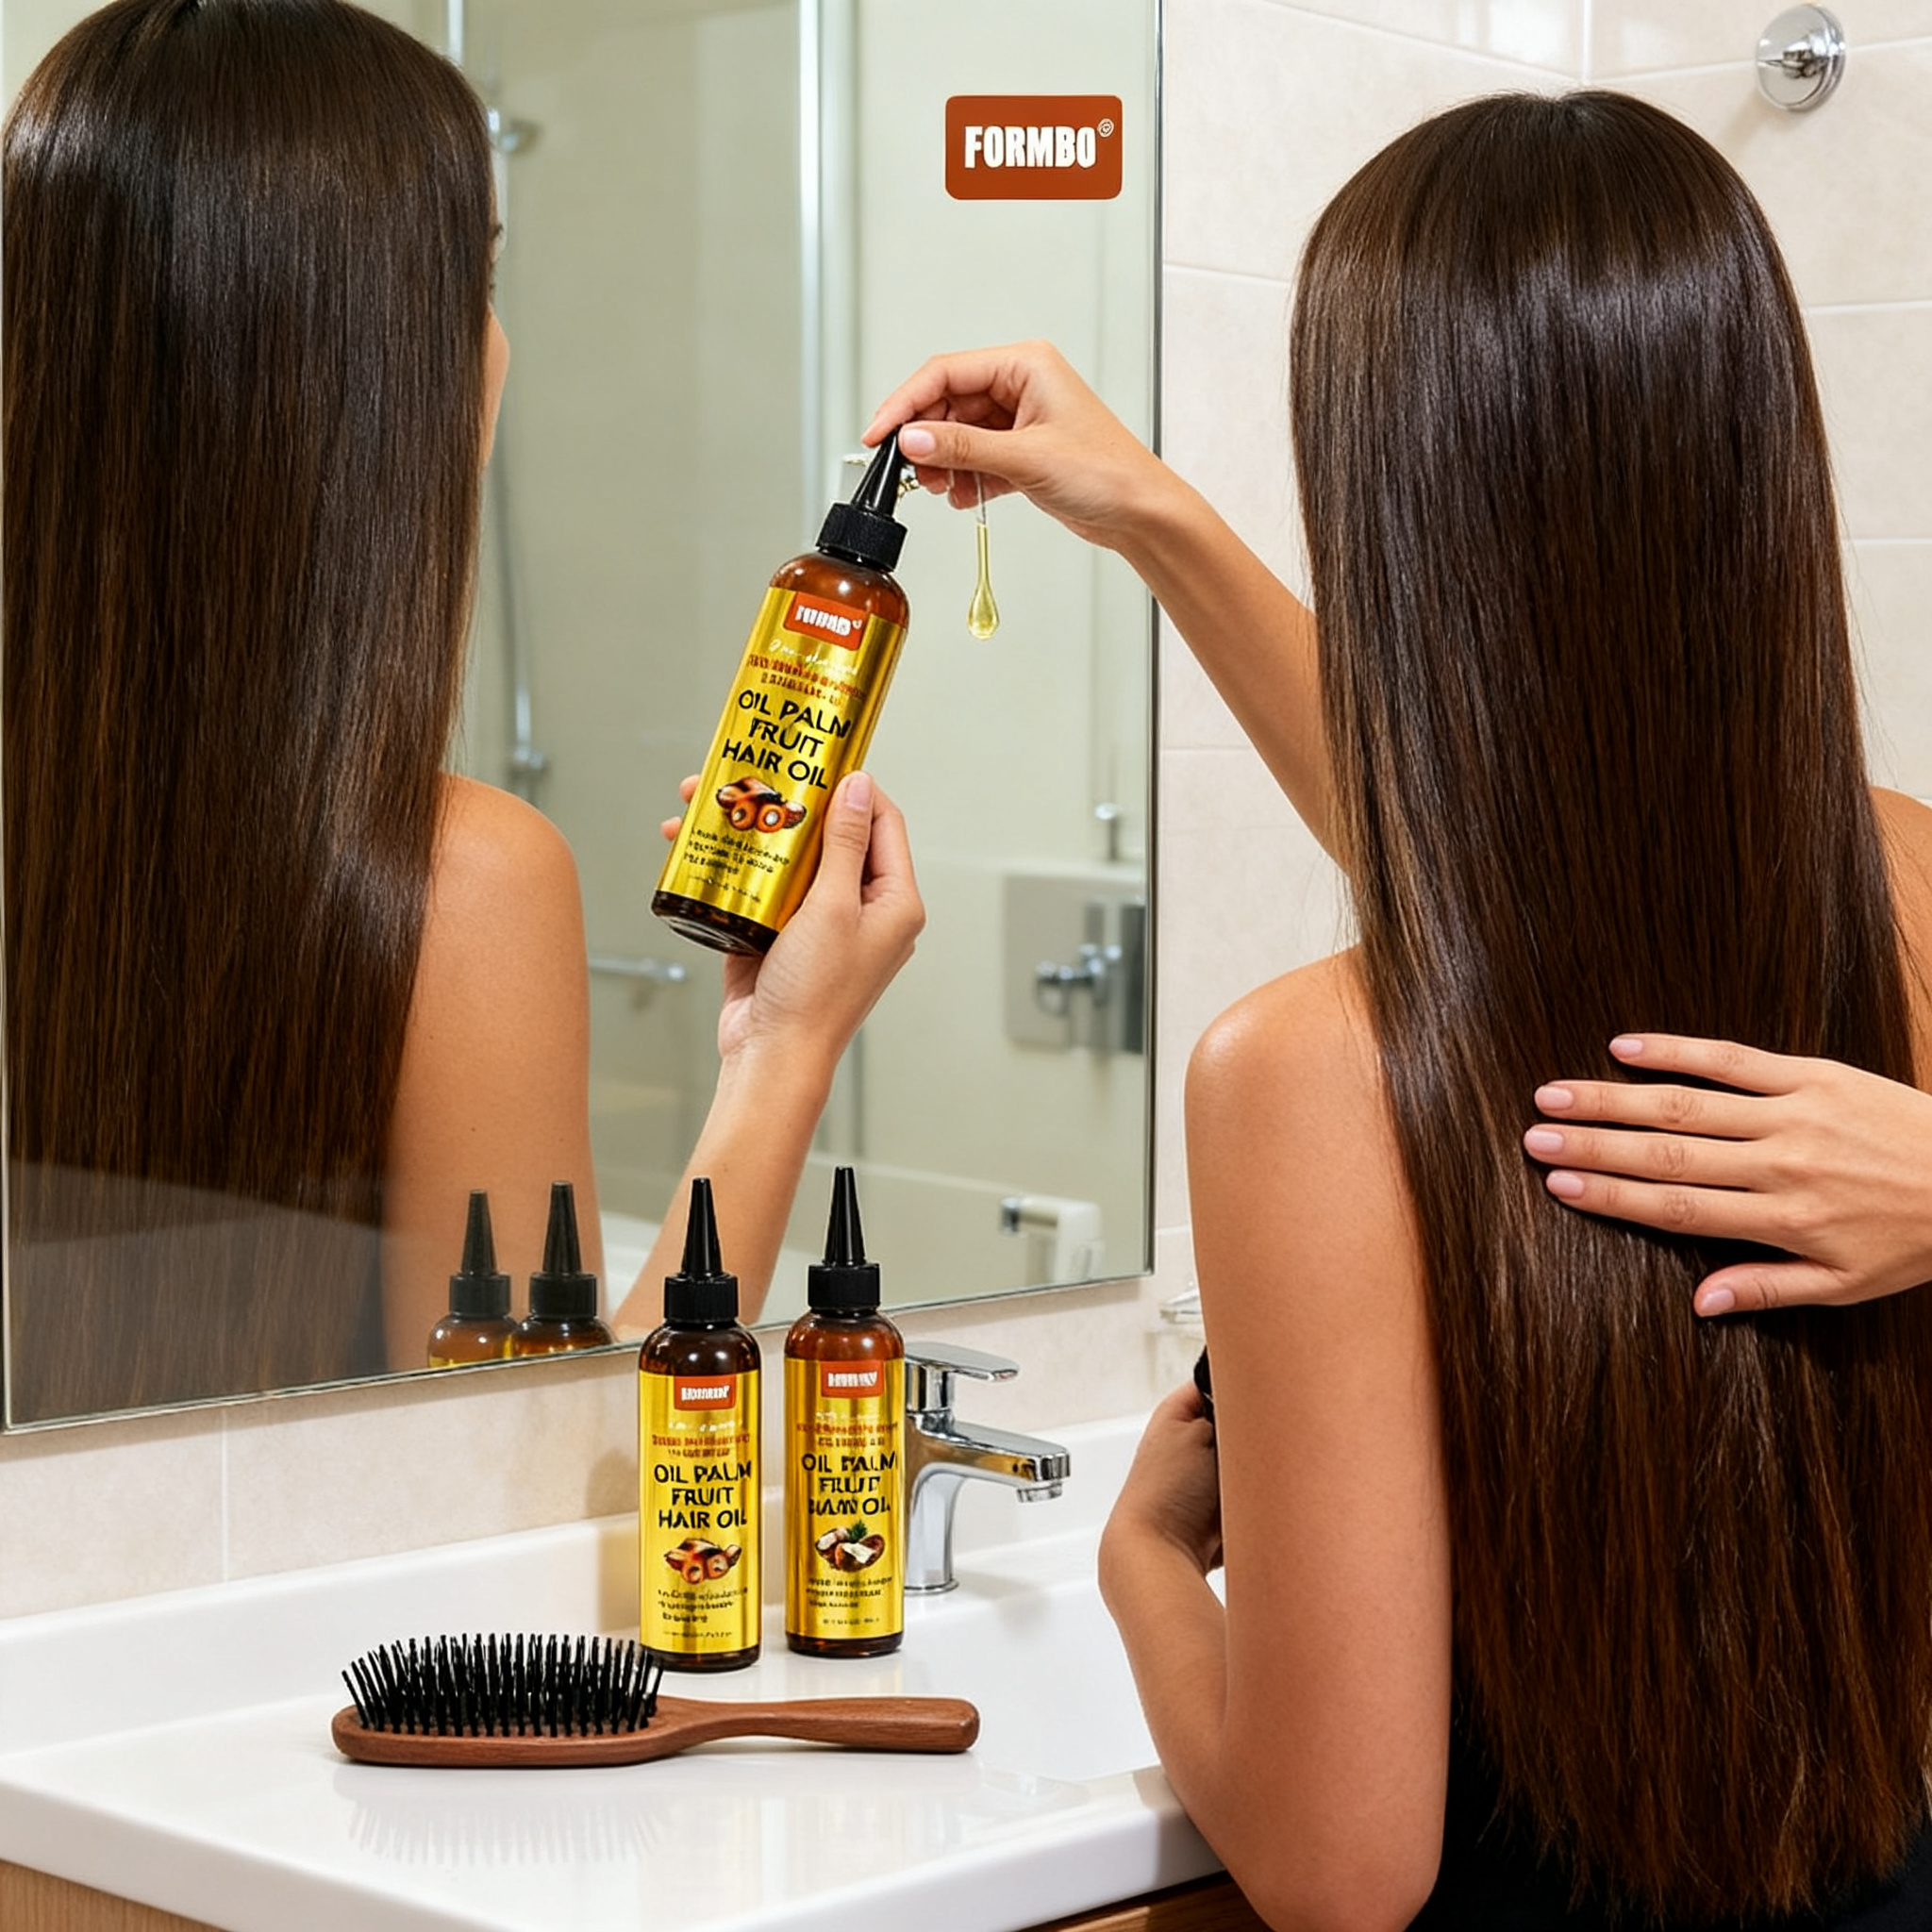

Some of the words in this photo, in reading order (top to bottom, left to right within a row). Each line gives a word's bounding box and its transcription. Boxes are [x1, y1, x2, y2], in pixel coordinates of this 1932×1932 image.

[739, 690, 771, 715] OIL
[748, 717, 824, 758] FRUIT
[722, 739, 782, 774] HAIR
[788, 760, 827, 791] OIL
[654, 1464, 689, 1483] OIL
[802, 1454, 832, 1473] OIL
[672, 1487, 734, 1506] FRUIT
[658, 1509, 710, 1528] HAIR
[717, 1508, 747, 1528] OIL
